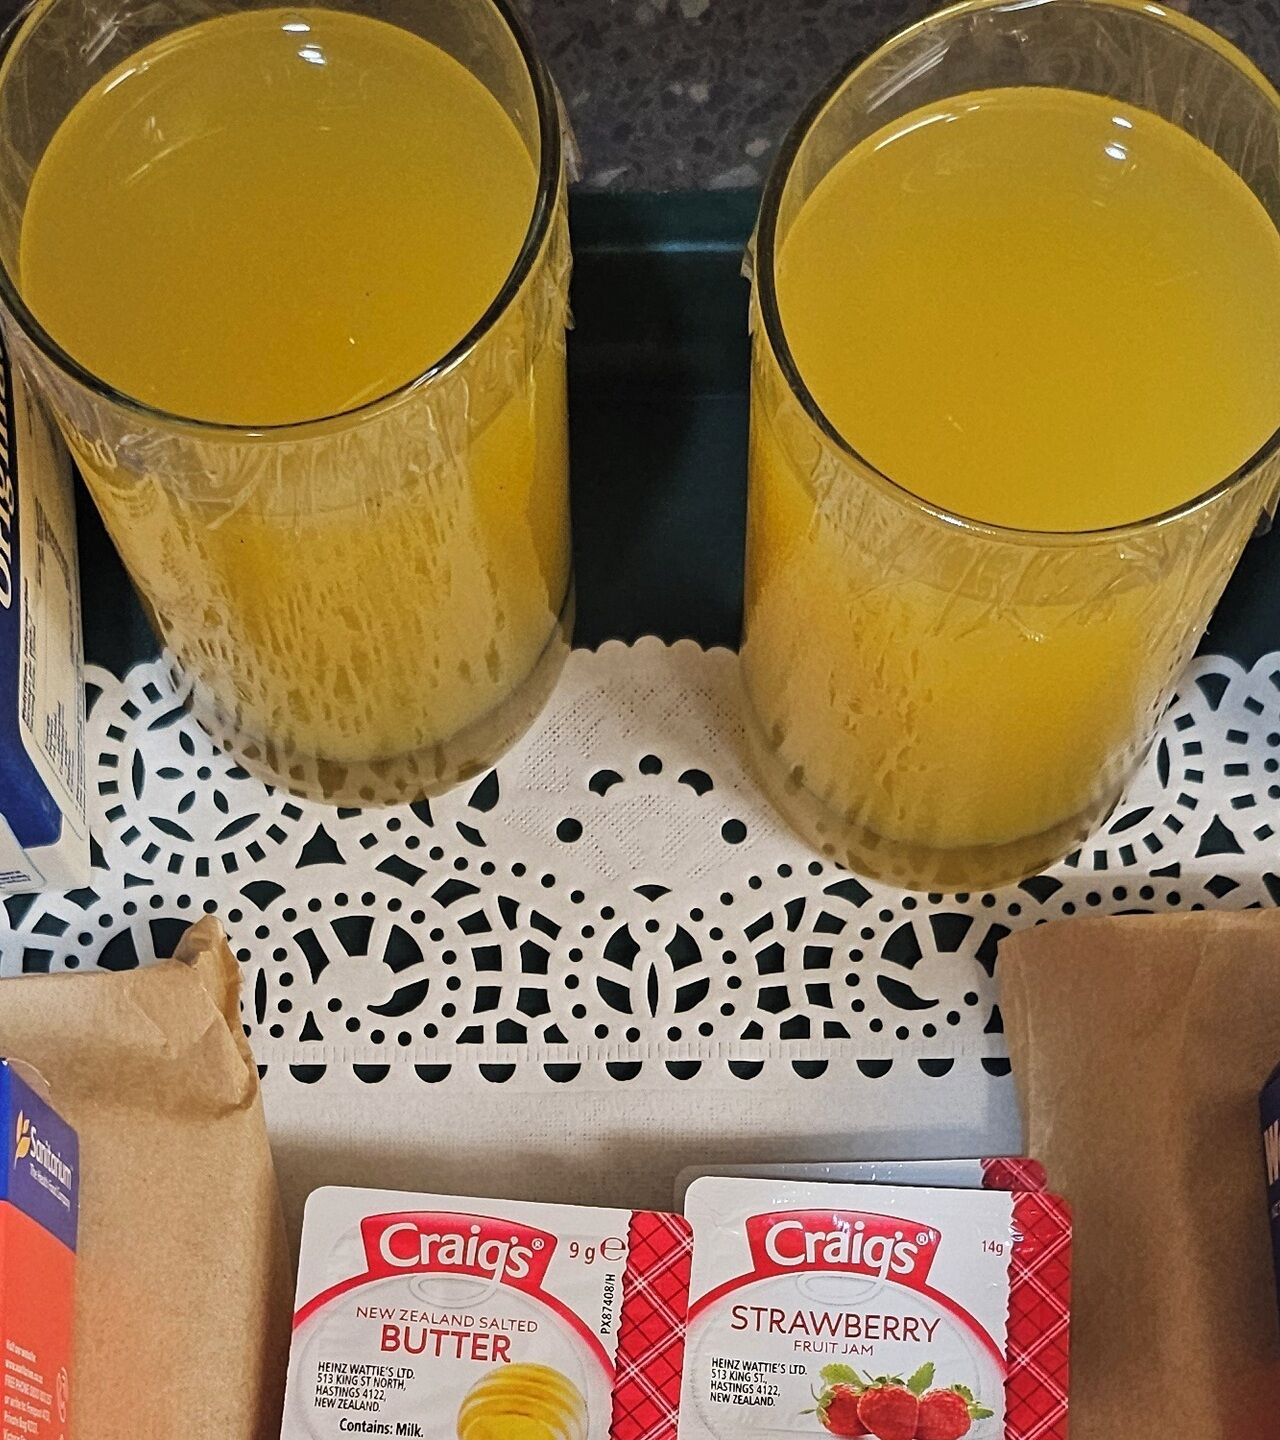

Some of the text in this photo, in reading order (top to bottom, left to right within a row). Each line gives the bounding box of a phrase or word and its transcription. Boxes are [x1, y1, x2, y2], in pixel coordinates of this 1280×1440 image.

[379, 1223, 596, 1286] Craig's 9 g
[765, 1220, 918, 1280] Craig's
[981, 1239, 1004, 1257] 14g
[600, 1273, 616, 1335] PX87408/H
[356, 1305, 538, 1333] NEW ZEALAND SALTED
[731, 1304, 942, 1343] STRAWBERRY
[380, 1324, 511, 1363] BUTTER
[793, 1340, 874, 1356] FRUIT JAM
[318, 1361, 415, 1380] HEINZ WATTIE'S LTD.
[711, 1358, 808, 1375] HEINZ WATTIE'S LTD.
[711, 1369, 727, 1381] 513
[729, 1370, 750, 1382] KING
[317, 1373, 406, 1391] 513 KING ST NORTH,
[710, 1381, 780, 1397] HASTINGS 4122,
[315, 1385, 387, 1402] HASTINGS 4122,
[710, 1391, 775, 1407] NEW ZEALAND.
[314, 1397, 381, 1412] NEW ZEALAND.
[339, 1418, 424, 1438] Contains: Milk.
